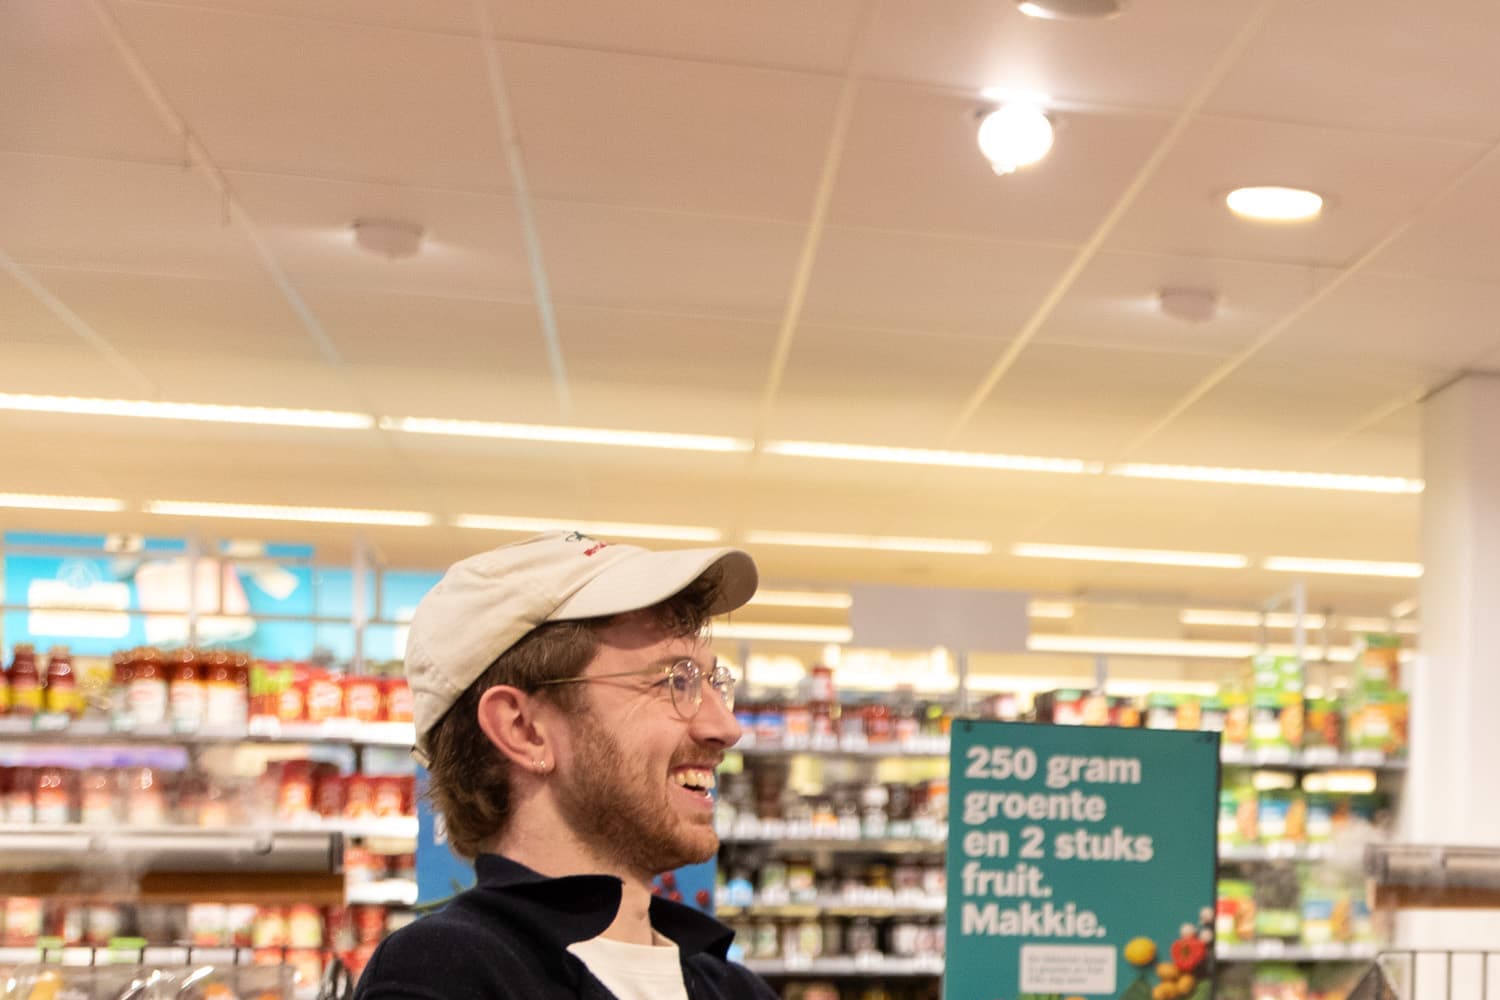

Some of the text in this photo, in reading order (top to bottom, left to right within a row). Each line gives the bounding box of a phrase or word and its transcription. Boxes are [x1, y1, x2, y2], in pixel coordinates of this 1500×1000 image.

[965, 746, 1141, 789] 250 gram
[962, 789, 1107, 825] groente
[962, 825, 1154, 862] en 2 stuks
[961, 861, 1053, 898] fruit.
[961, 902, 1107, 938] Makkie.
